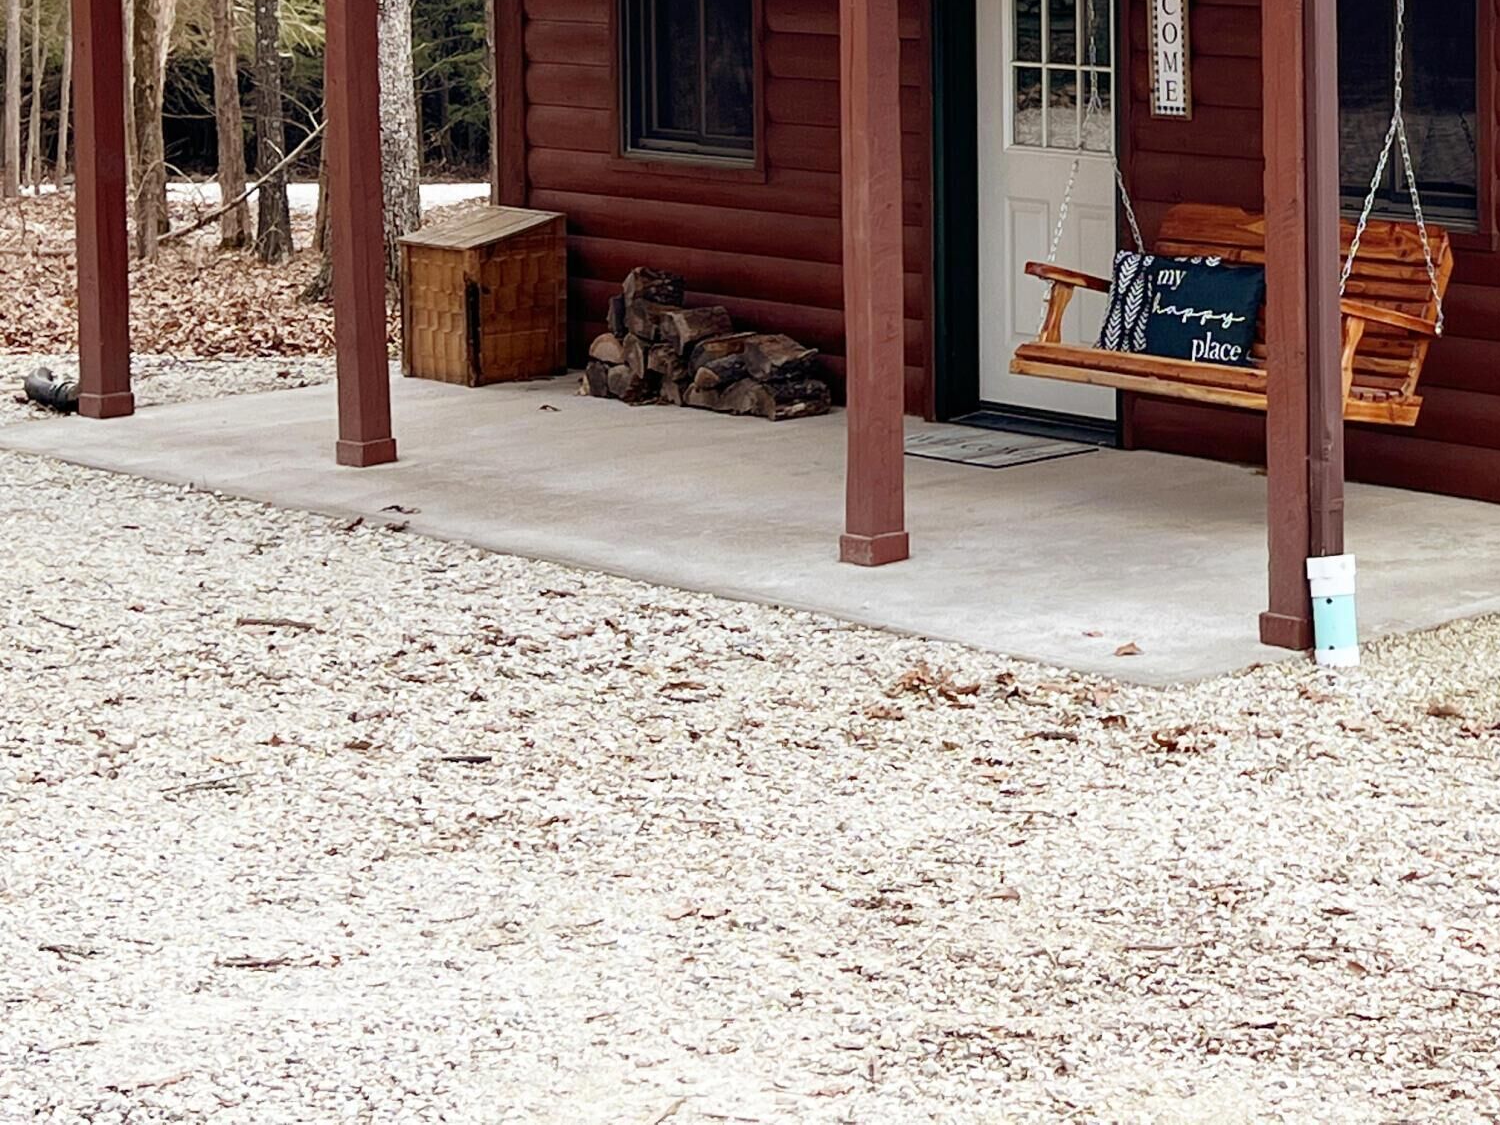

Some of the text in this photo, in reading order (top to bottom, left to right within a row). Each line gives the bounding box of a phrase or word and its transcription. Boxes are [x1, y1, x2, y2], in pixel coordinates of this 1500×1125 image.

[1156, 268, 1187, 291] my
[1151, 292, 1246, 329] happy
[1191, 331, 1242, 362] place
